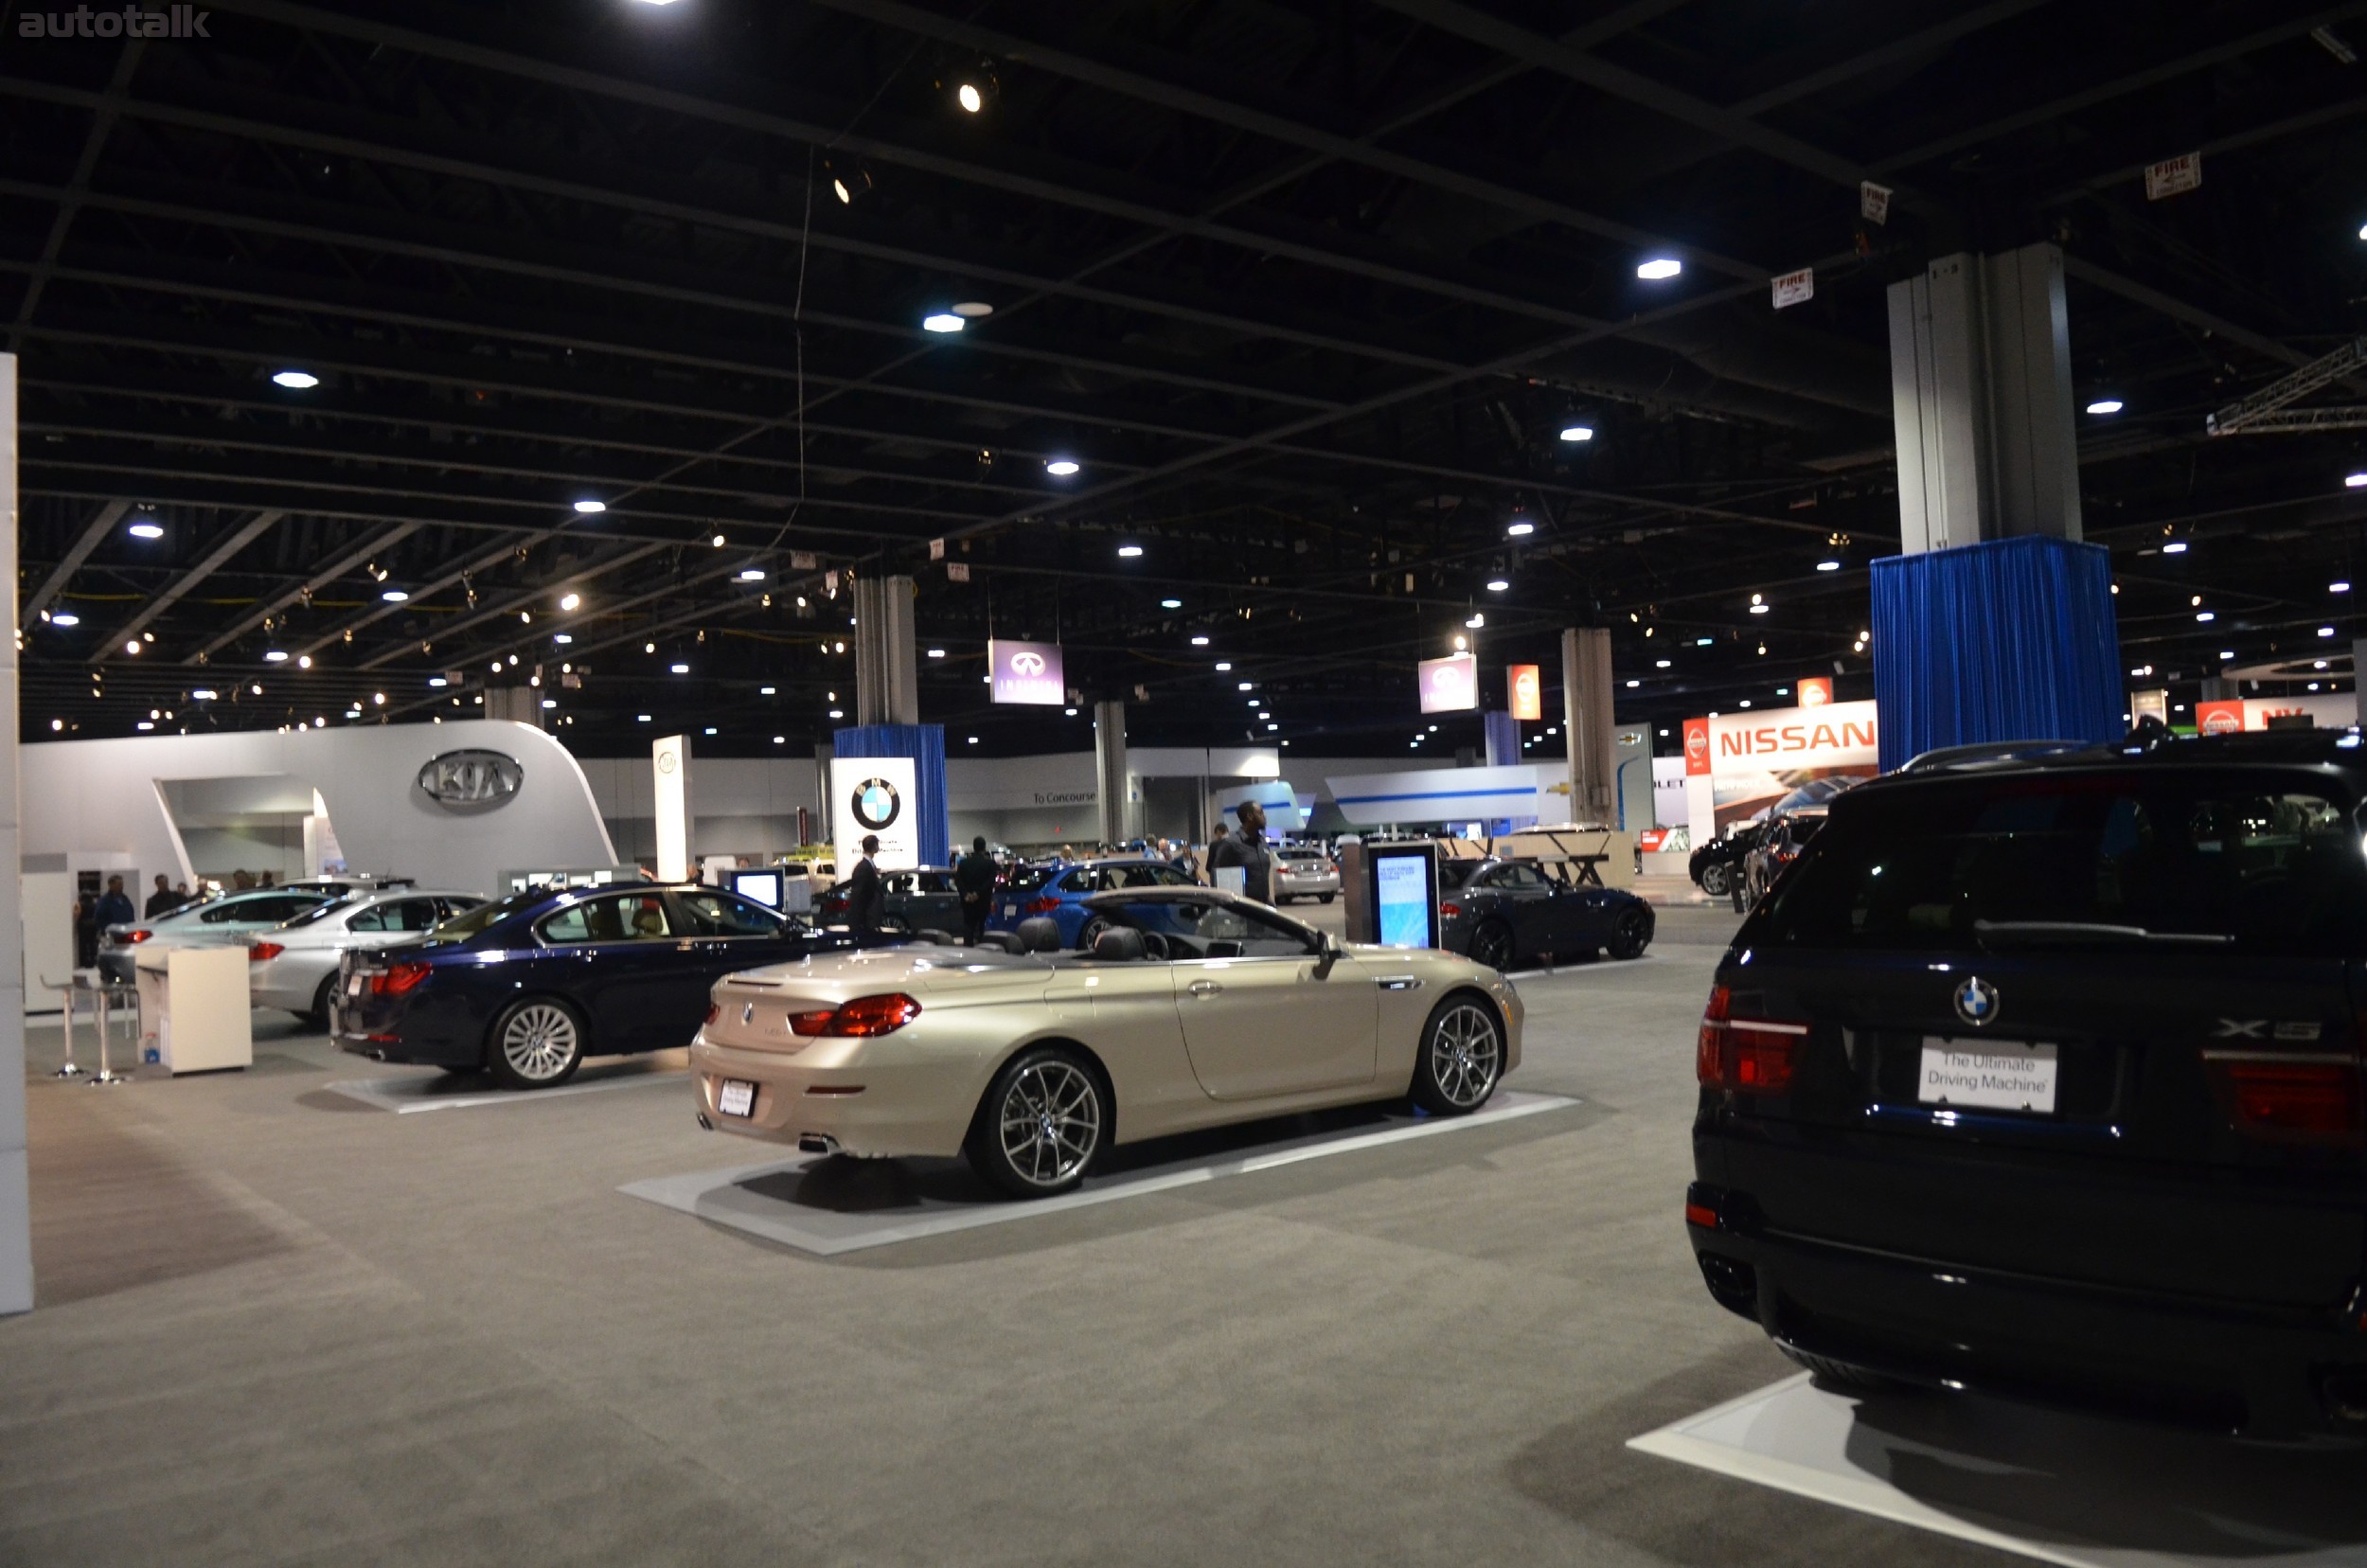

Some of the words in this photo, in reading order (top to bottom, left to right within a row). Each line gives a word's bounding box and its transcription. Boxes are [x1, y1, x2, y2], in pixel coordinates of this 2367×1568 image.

[2154, 156, 2189, 178] FIRE
[1779, 272, 1805, 289] FIRE
[1720, 721, 1875, 757] NISSAN
[435, 761, 508, 797] KIA
[855, 777, 898, 797] BMW
[1034, 793, 1045, 804] To
[1046, 791, 1096, 804] Concourse
[2209, 1018, 2323, 1041] X5
[1942, 1051, 1970, 1068] The
[1973, 1053, 2036, 1073] Ultimate
[1929, 1069, 1978, 1092] Driving
